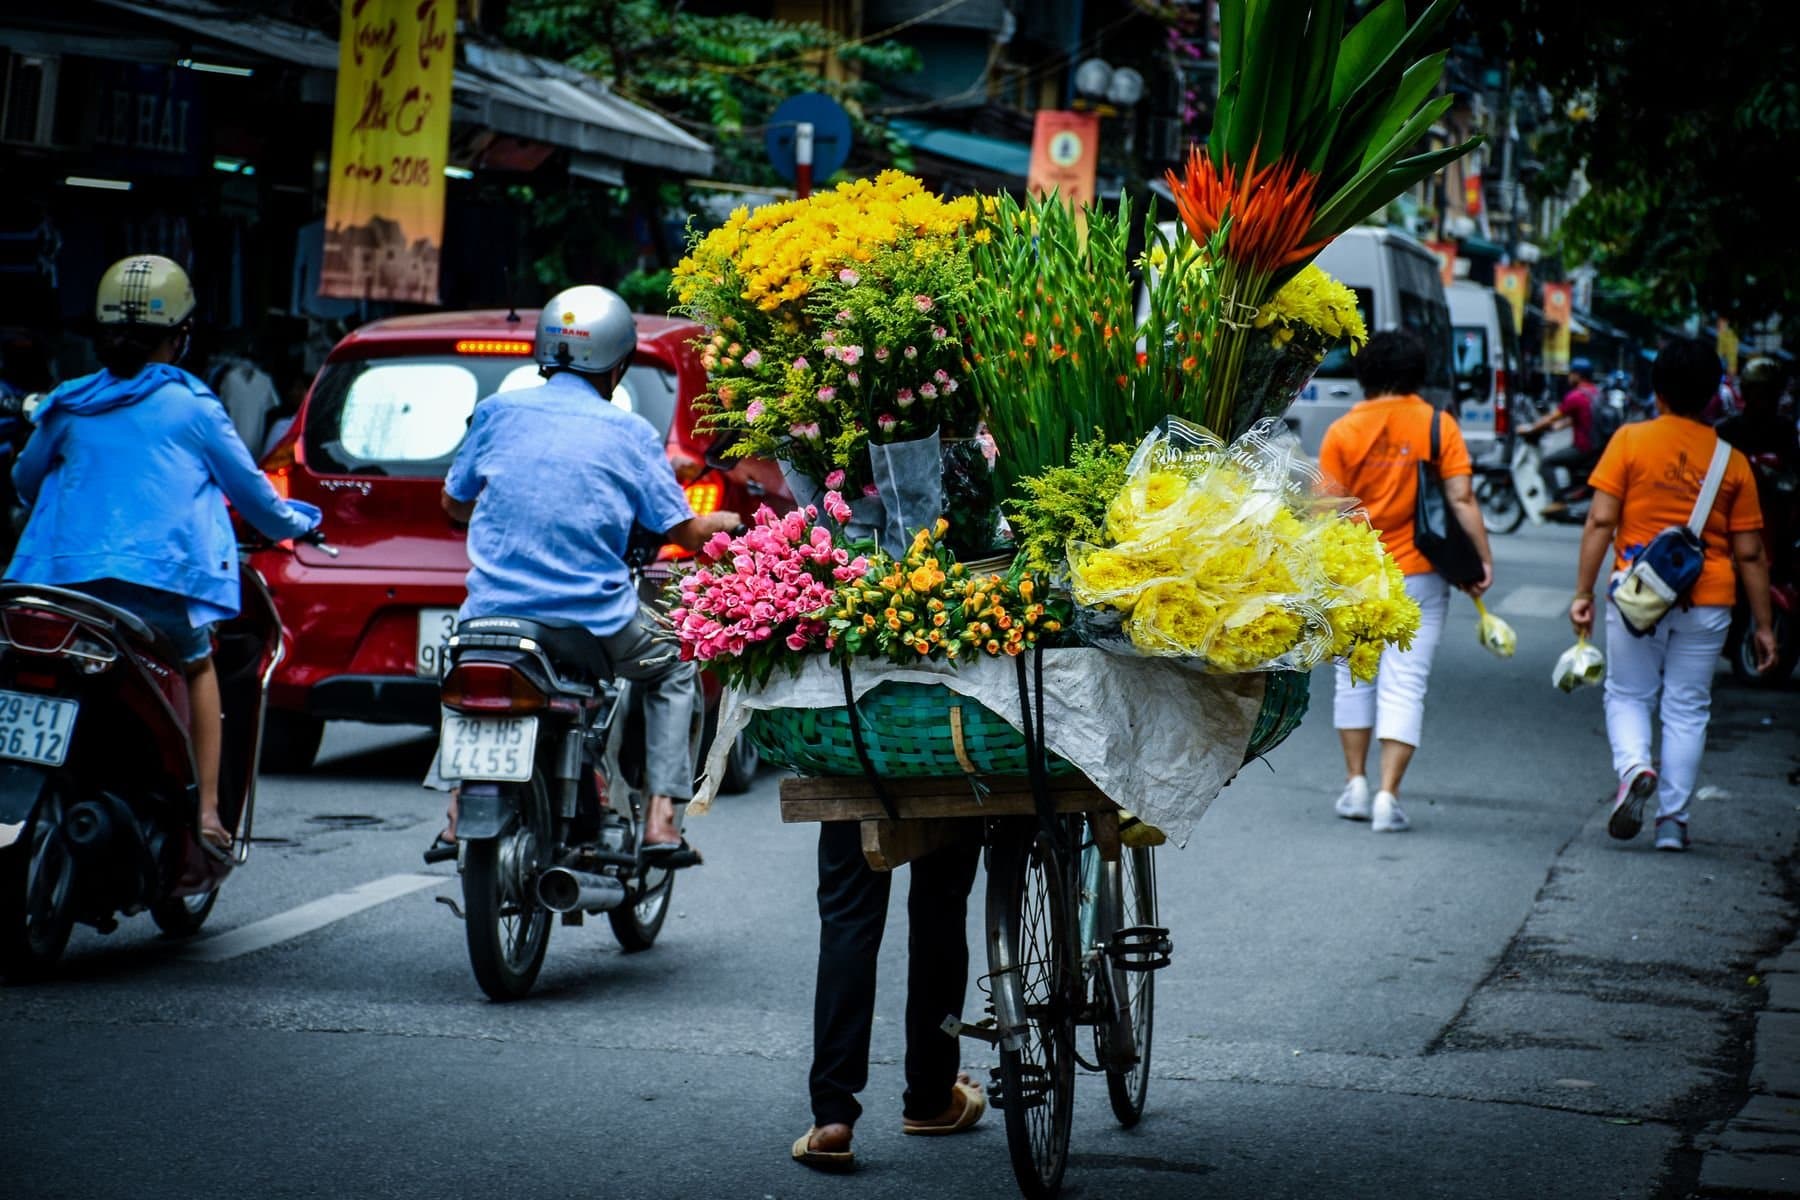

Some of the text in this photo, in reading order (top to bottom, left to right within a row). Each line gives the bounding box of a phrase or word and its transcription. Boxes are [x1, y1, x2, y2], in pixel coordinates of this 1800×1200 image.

[389, 157, 431, 187] 2018
[454, 719, 523, 745] 29-H5
[451, 747, 518, 775] 4455
